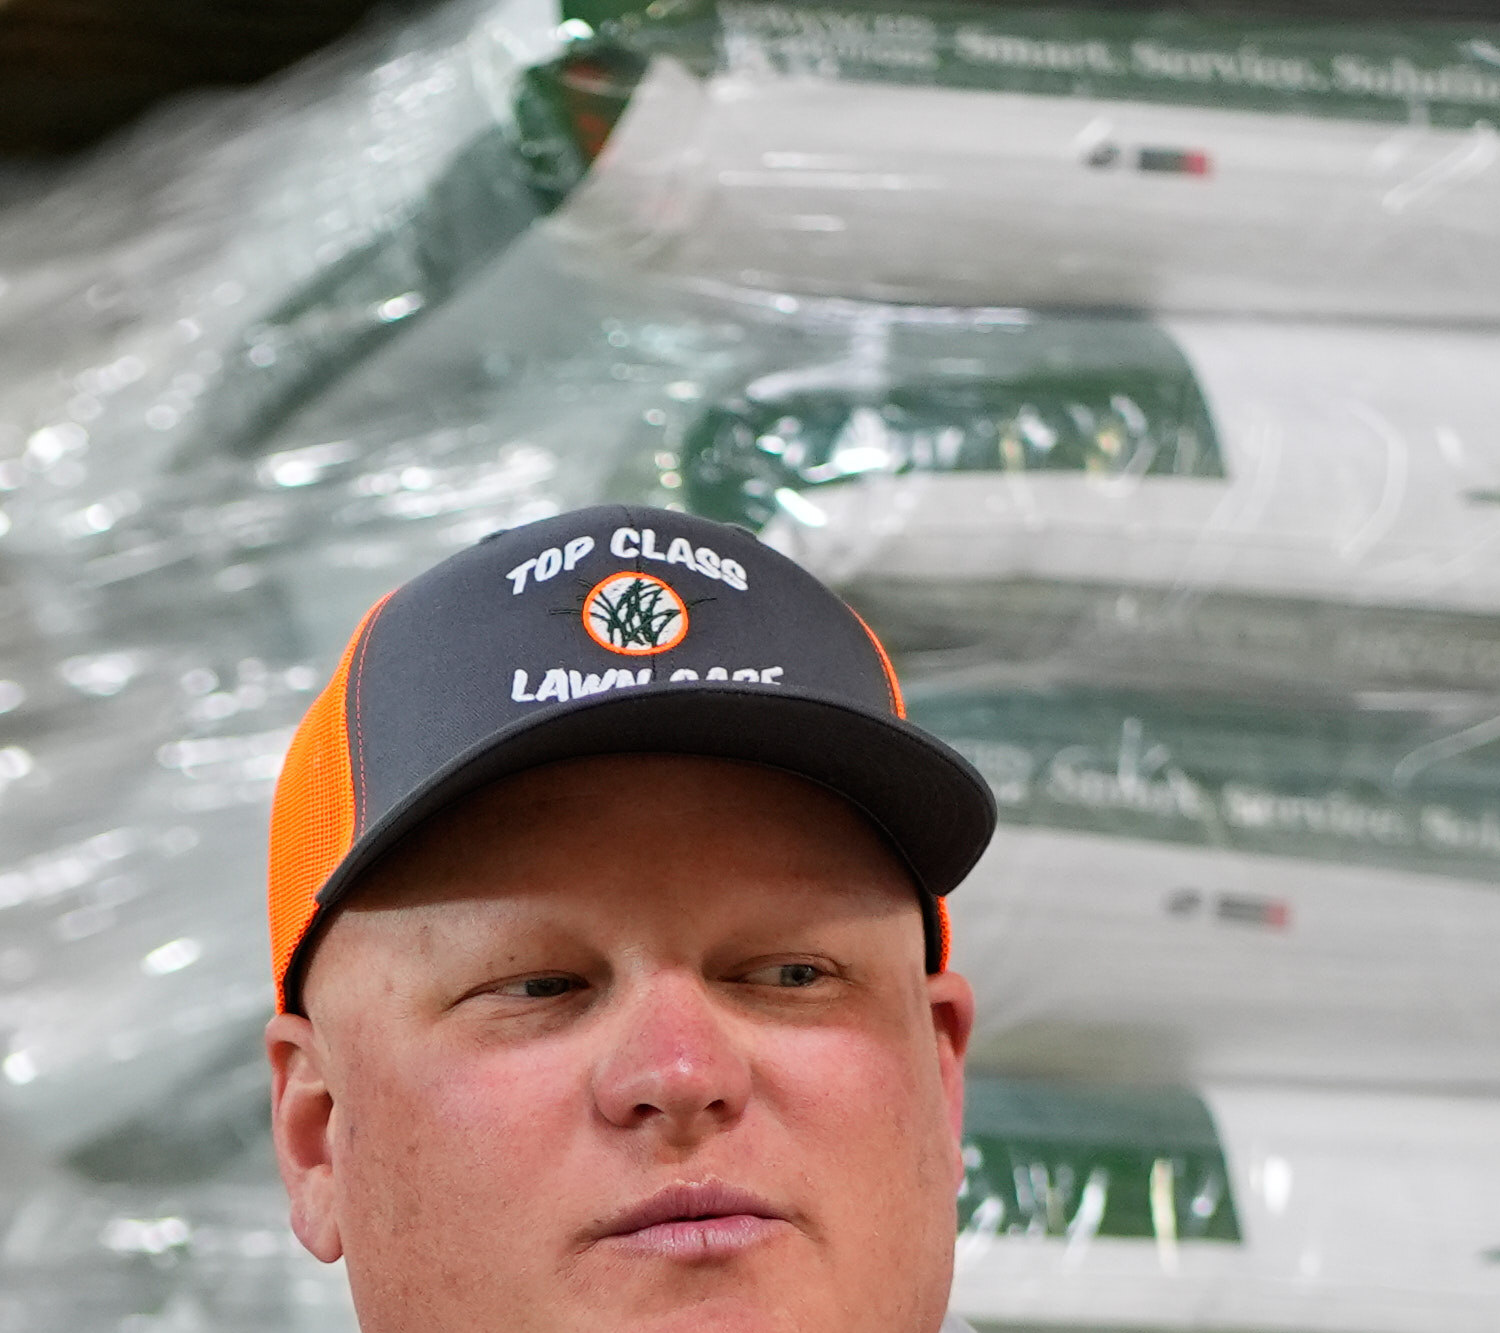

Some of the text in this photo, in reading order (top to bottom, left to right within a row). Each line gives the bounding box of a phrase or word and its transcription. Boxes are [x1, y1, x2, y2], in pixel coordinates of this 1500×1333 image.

[505, 527, 749, 595] TOP CLASS
[511, 666, 653, 703] LAWN
